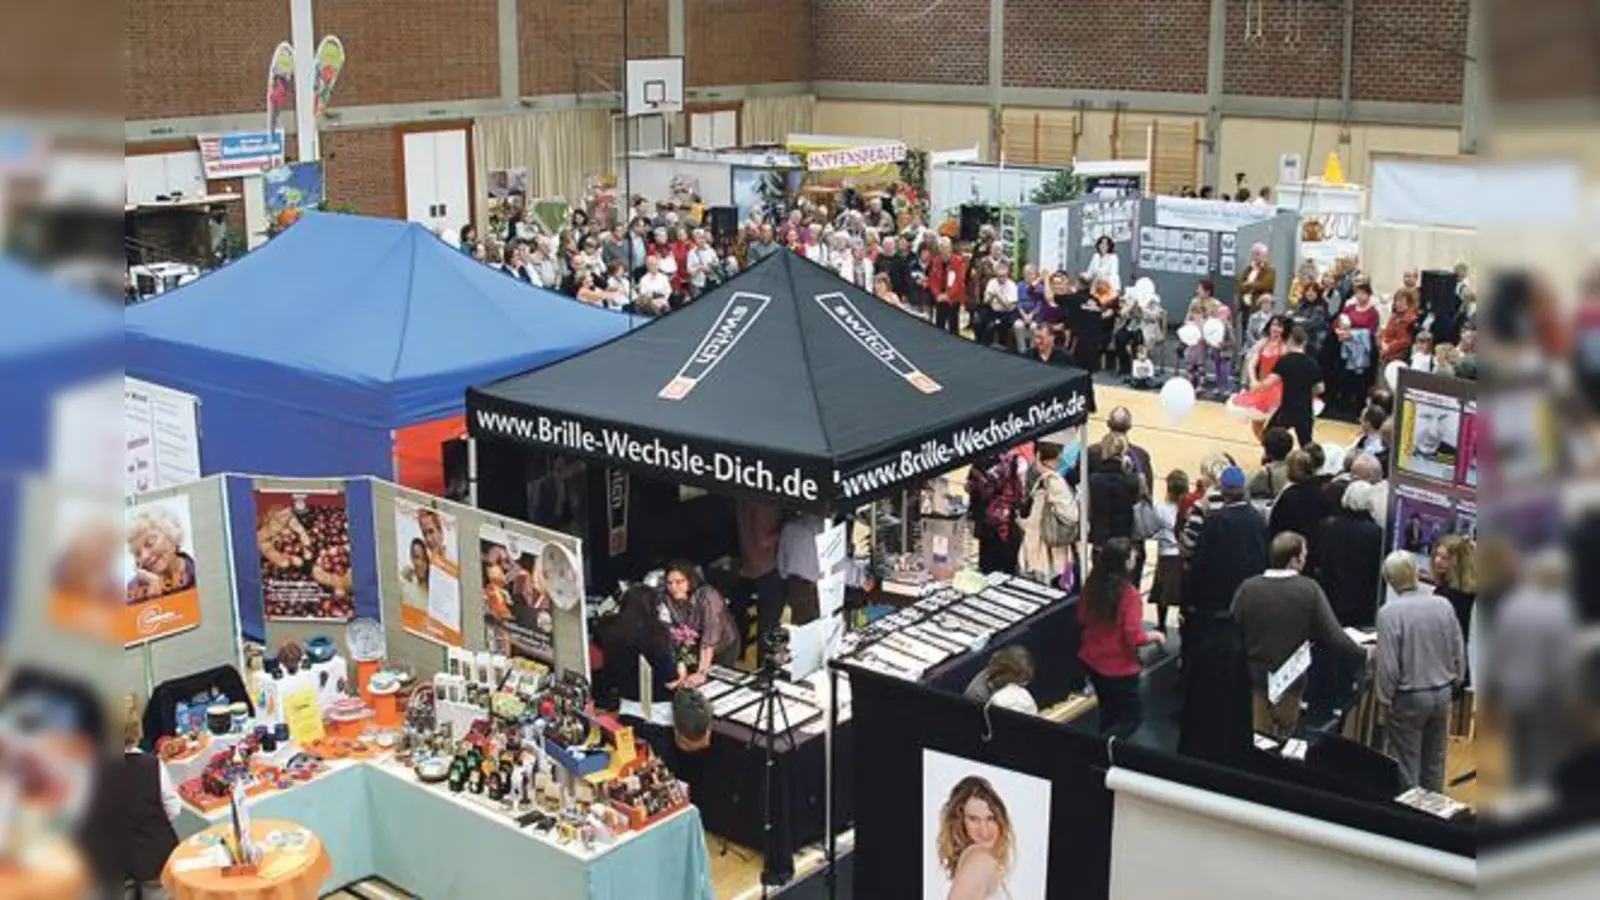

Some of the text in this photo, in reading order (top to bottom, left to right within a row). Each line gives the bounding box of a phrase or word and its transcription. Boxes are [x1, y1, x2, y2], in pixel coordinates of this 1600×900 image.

[695, 306, 748, 363] switch
[834, 305, 896, 361] switch
[477, 409, 818, 500] www.Brille-Wechsle-Dich.de
[833, 390, 1086, 498] www.Brille-Wechsle-Dich.de
